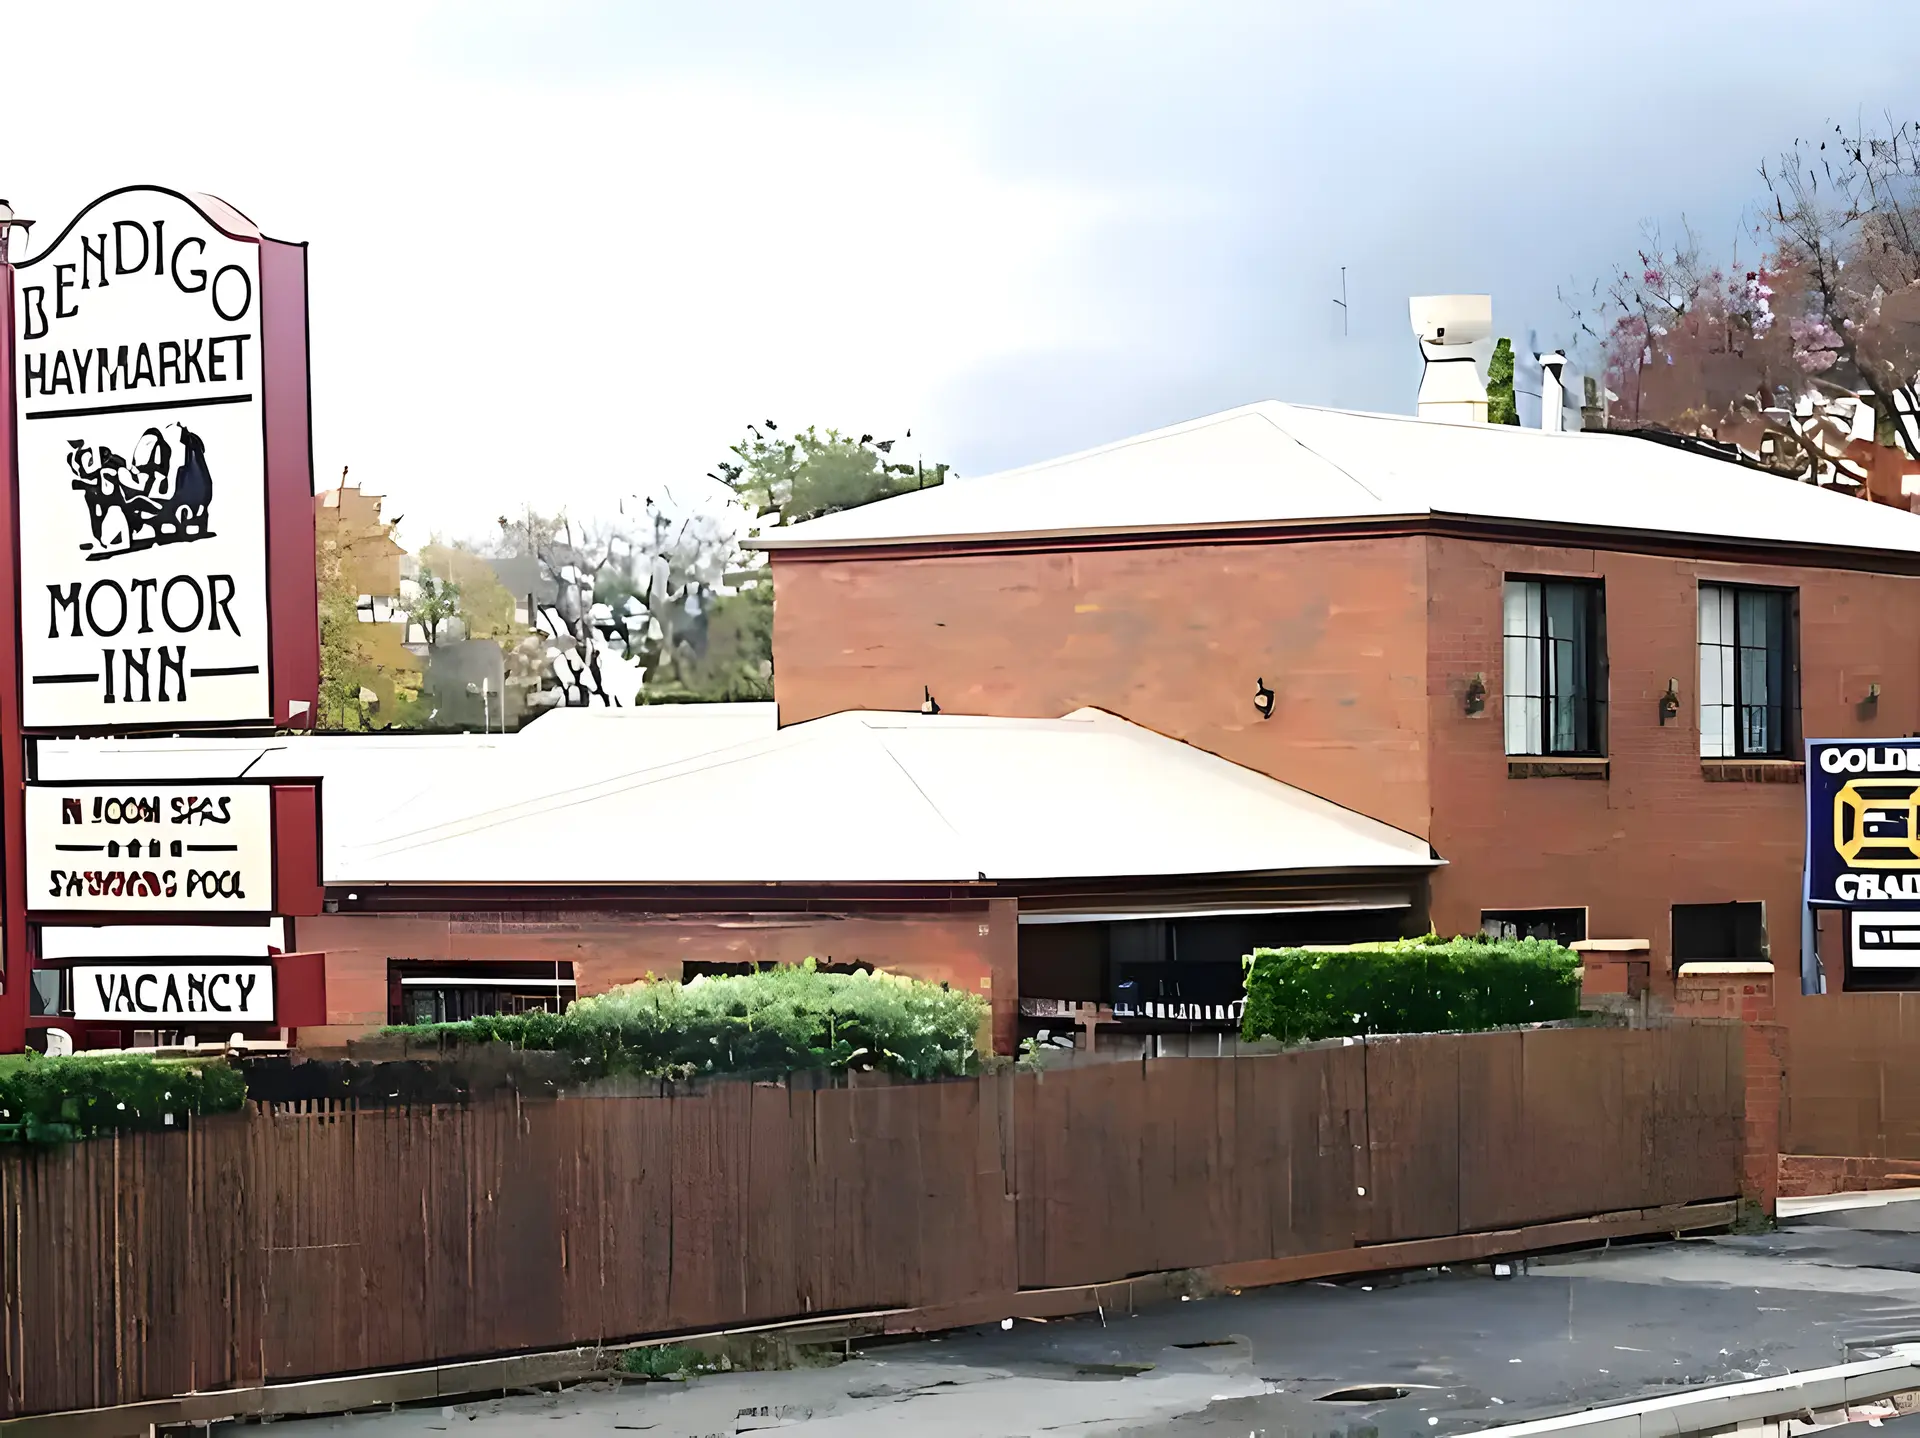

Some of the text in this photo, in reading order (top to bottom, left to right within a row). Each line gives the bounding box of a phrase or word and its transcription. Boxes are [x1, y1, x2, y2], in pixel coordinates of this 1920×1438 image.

[22, 219, 252, 341] BENDIGO
[24, 333, 252, 398] HAYMARKET
[45, 574, 242, 638] MOTOR
[101, 645, 187, 704] INN
[94, 973, 256, 1013] VACANCY
